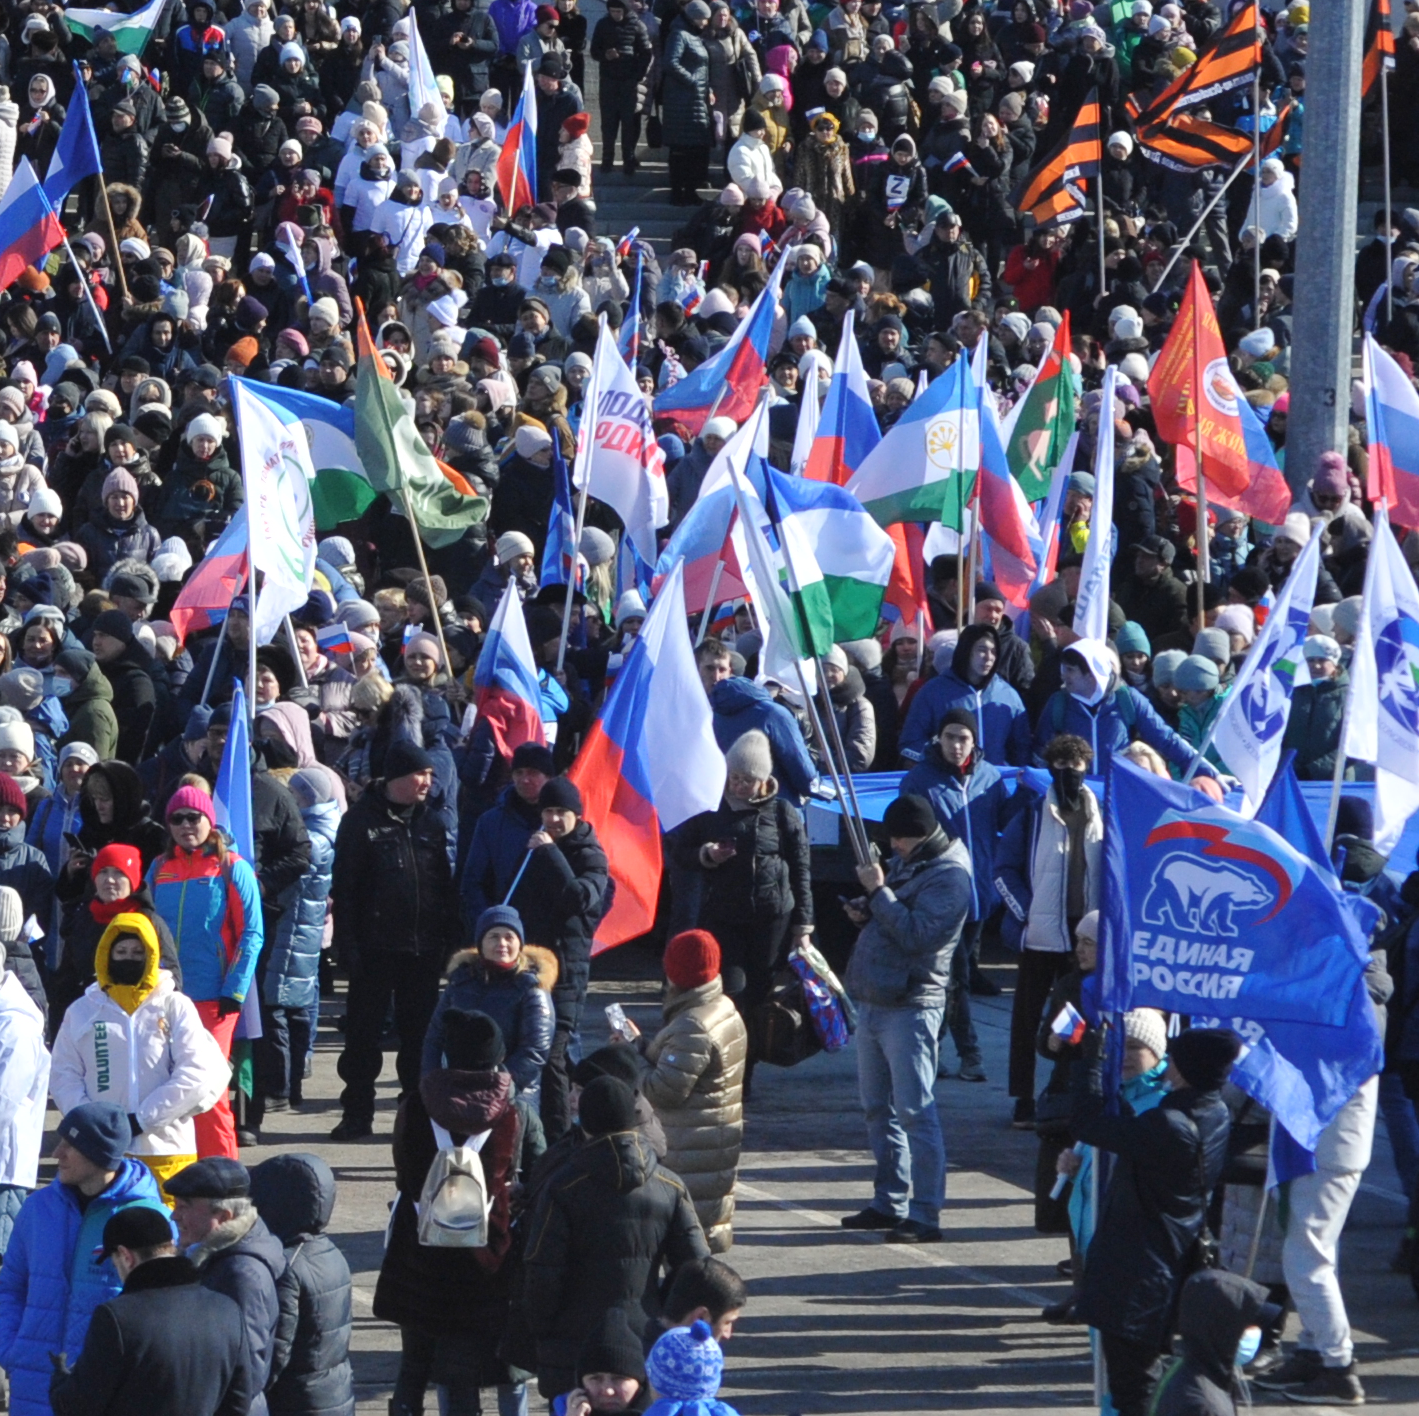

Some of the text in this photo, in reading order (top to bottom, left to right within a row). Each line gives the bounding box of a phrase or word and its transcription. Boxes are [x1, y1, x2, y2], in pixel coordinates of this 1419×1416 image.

[890, 176, 905, 195] Z
[1132, 930, 1255, 973] ЕДИНАЯ
[1132, 962, 1244, 999] РОССИЯ
